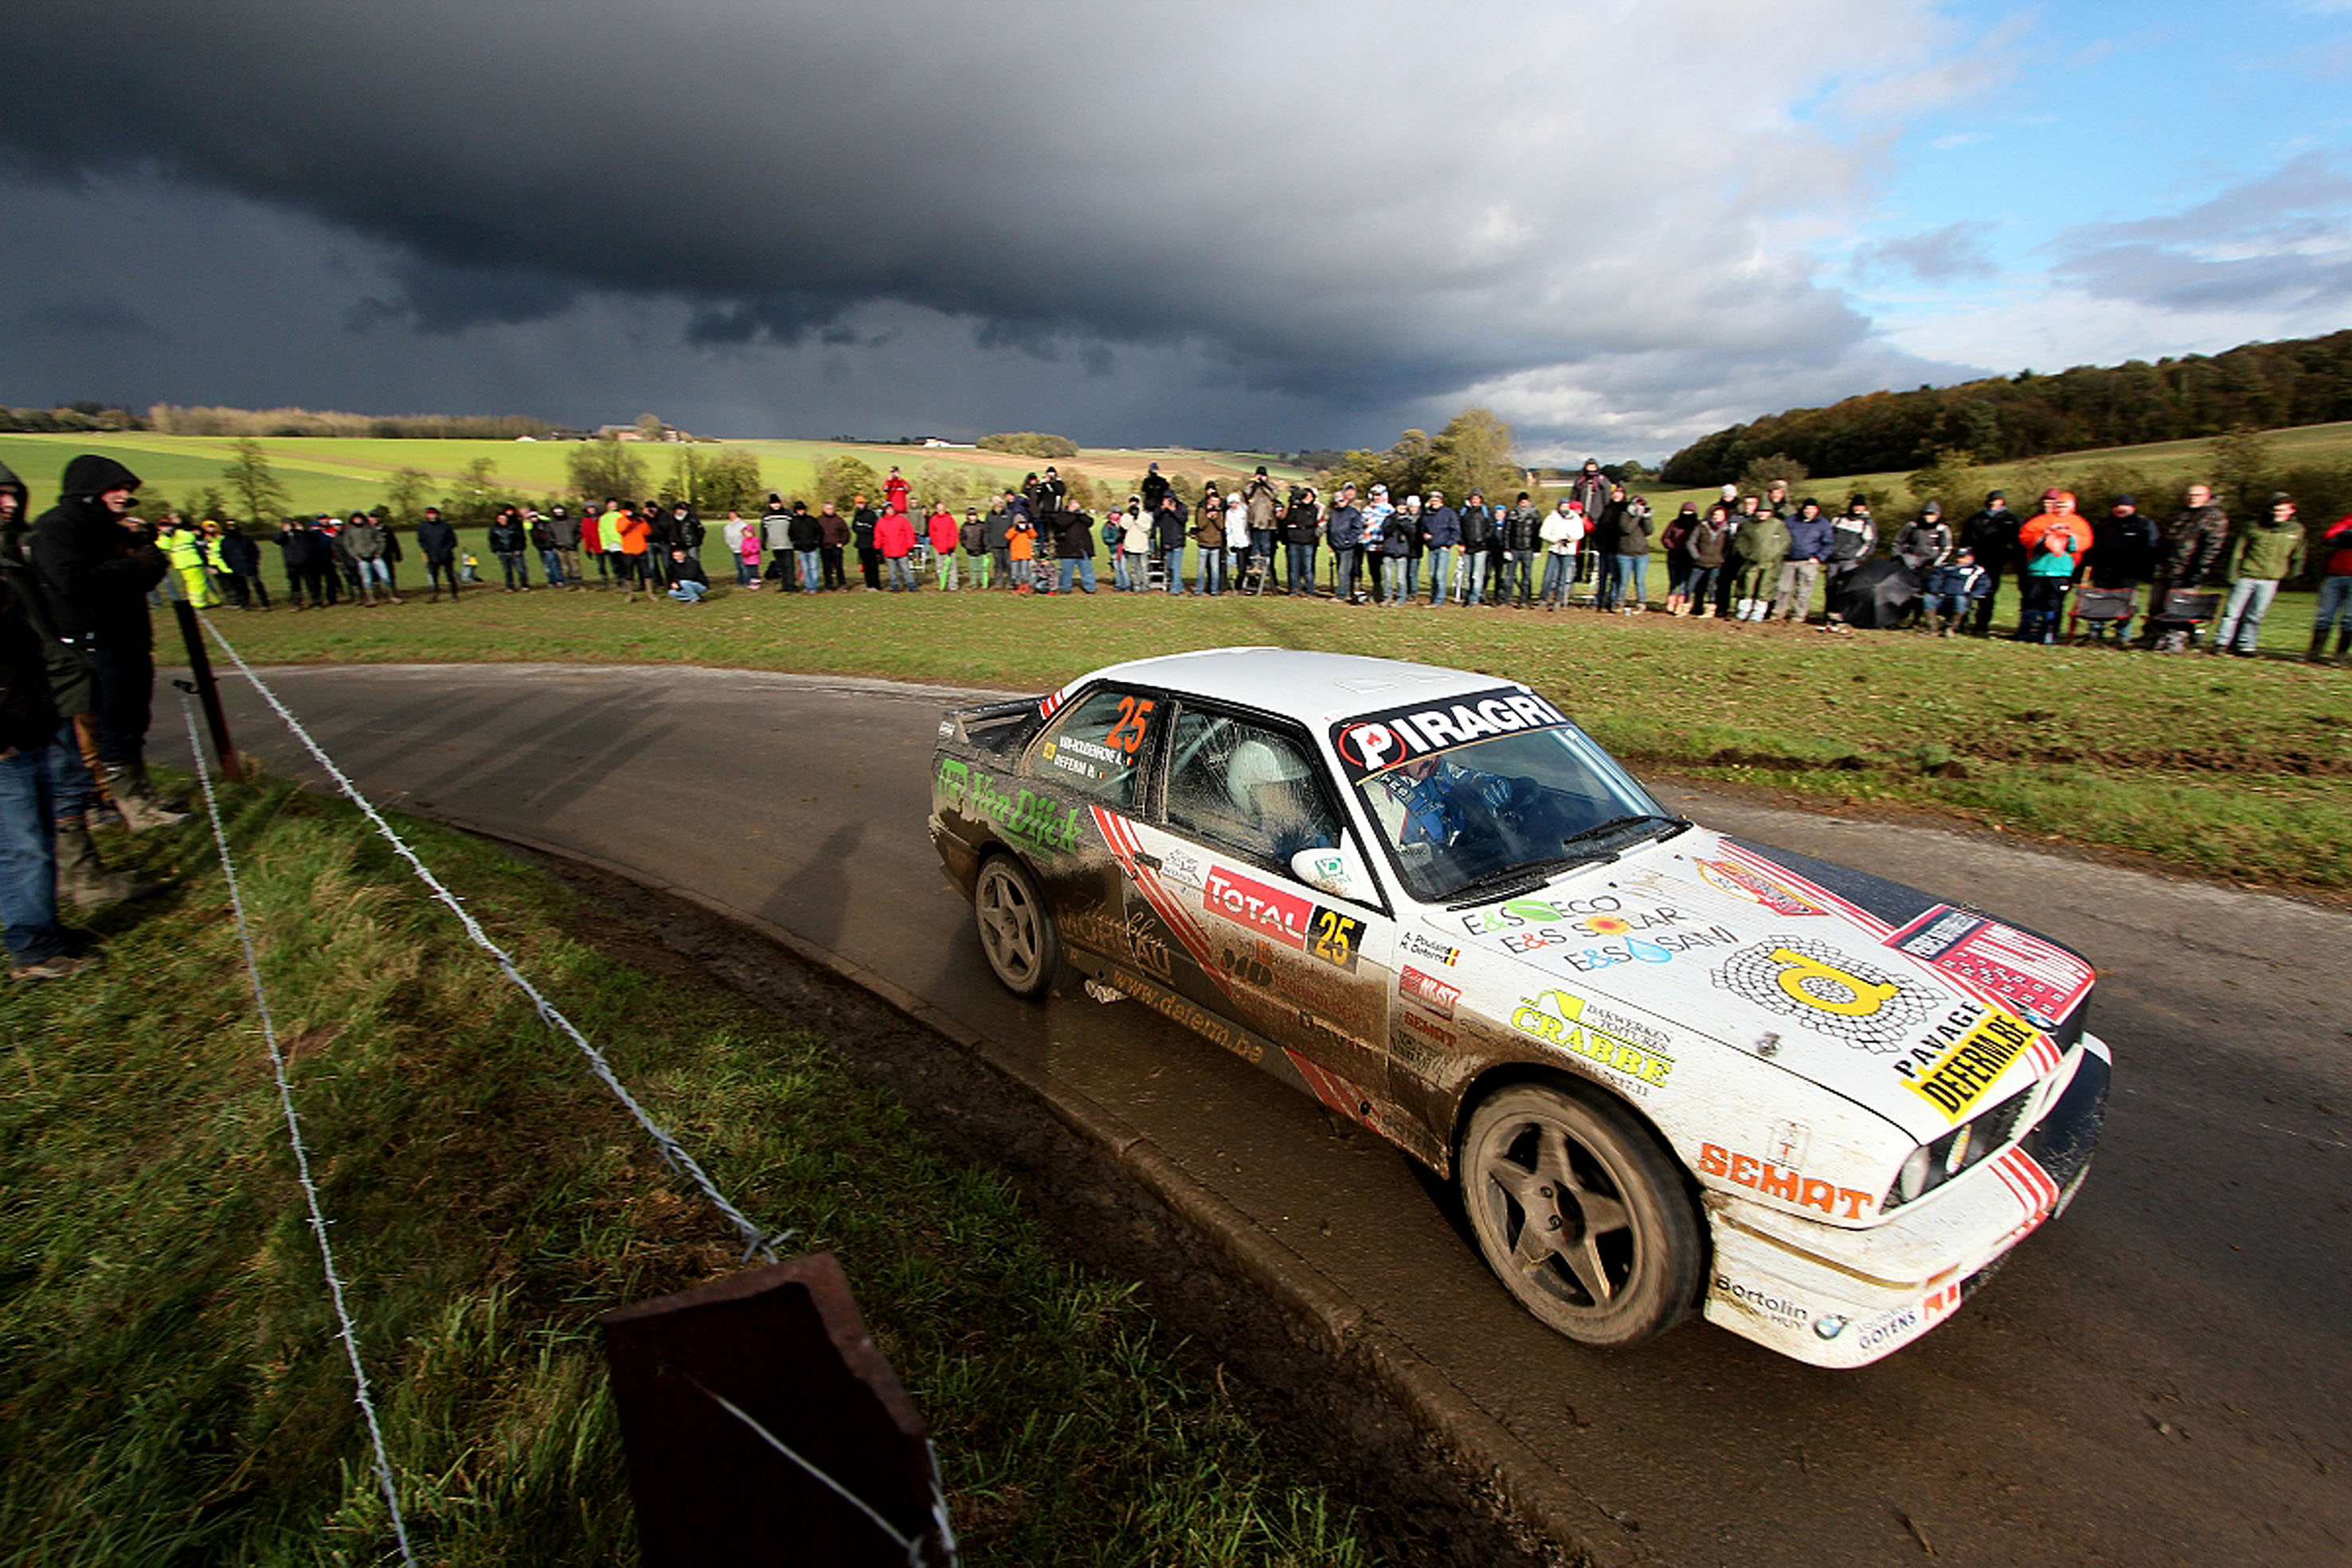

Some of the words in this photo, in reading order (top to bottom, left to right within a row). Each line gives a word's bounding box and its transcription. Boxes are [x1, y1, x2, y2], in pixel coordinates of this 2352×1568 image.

[1105, 696, 1155, 753] 25
[1348, 694, 1568, 771] PIRAGRI
[1207, 874, 1304, 940] TOTAL
[1317, 909, 1356, 965] 25
[1462, 906, 1525, 935] E&S
[1551, 895, 1622, 918] ECO
[1501, 928, 1567, 954] E&S
[1564, 945, 1633, 972] E&S
[1655, 924, 1740, 954] SANI
[1113, 969, 1264, 1063] www.deferm.be
[1511, 1006, 1672, 1089] CRABBE
[1893, 1001, 1985, 1078] PAVAGE
[1920, 1015, 2033, 1114] DEFERM.BE
[1698, 1142, 1874, 1220] SEMAT
